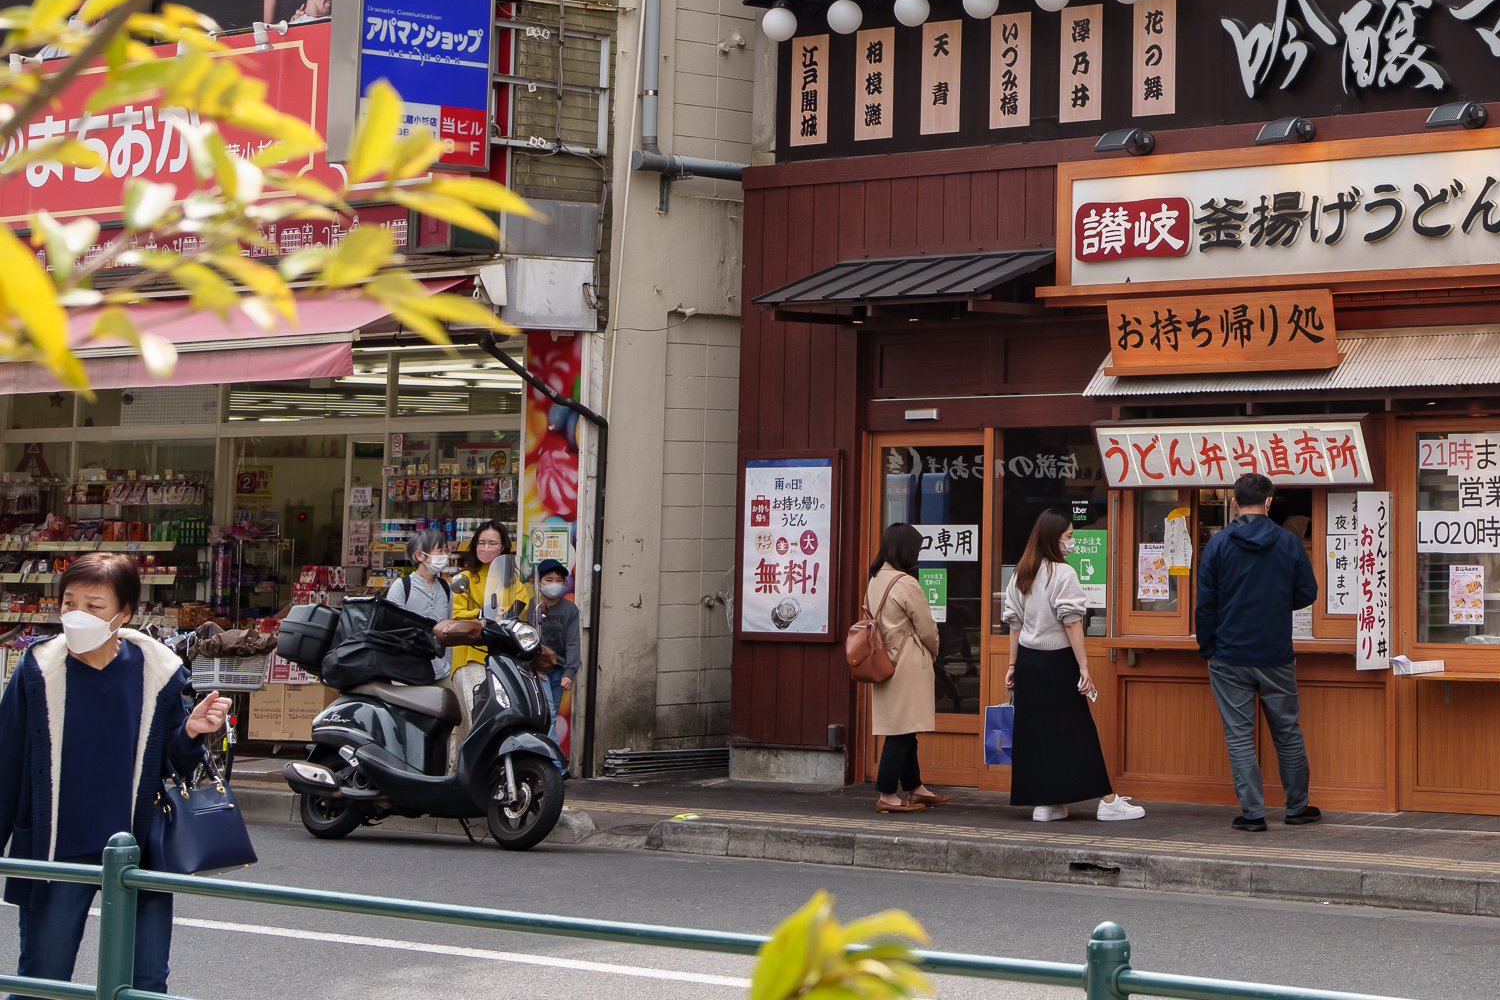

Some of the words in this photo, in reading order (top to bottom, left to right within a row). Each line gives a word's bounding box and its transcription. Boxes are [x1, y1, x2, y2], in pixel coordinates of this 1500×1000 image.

[366, 16, 484, 53] アパマンショップ
[864, 40, 884, 128] 相模灘
[442, 116, 483, 137] 当ビル
[1116, 302, 1326, 352] お持ち帰り処
[1104, 429, 1359, 484] うどん弁当直売所
[772, 495, 826, 511] お持ち帰りの
[781, 512, 808, 528] うどん
[1072, 506, 1087, 514] Uber
[803, 534, 815, 550] 大
[919, 527, 974, 558] 口専用
[1334, 514, 1349, 606] 夜21時まで
[754, 557, 820, 595] 無料!
[1358, 523, 1376, 661] お持ち帰り
